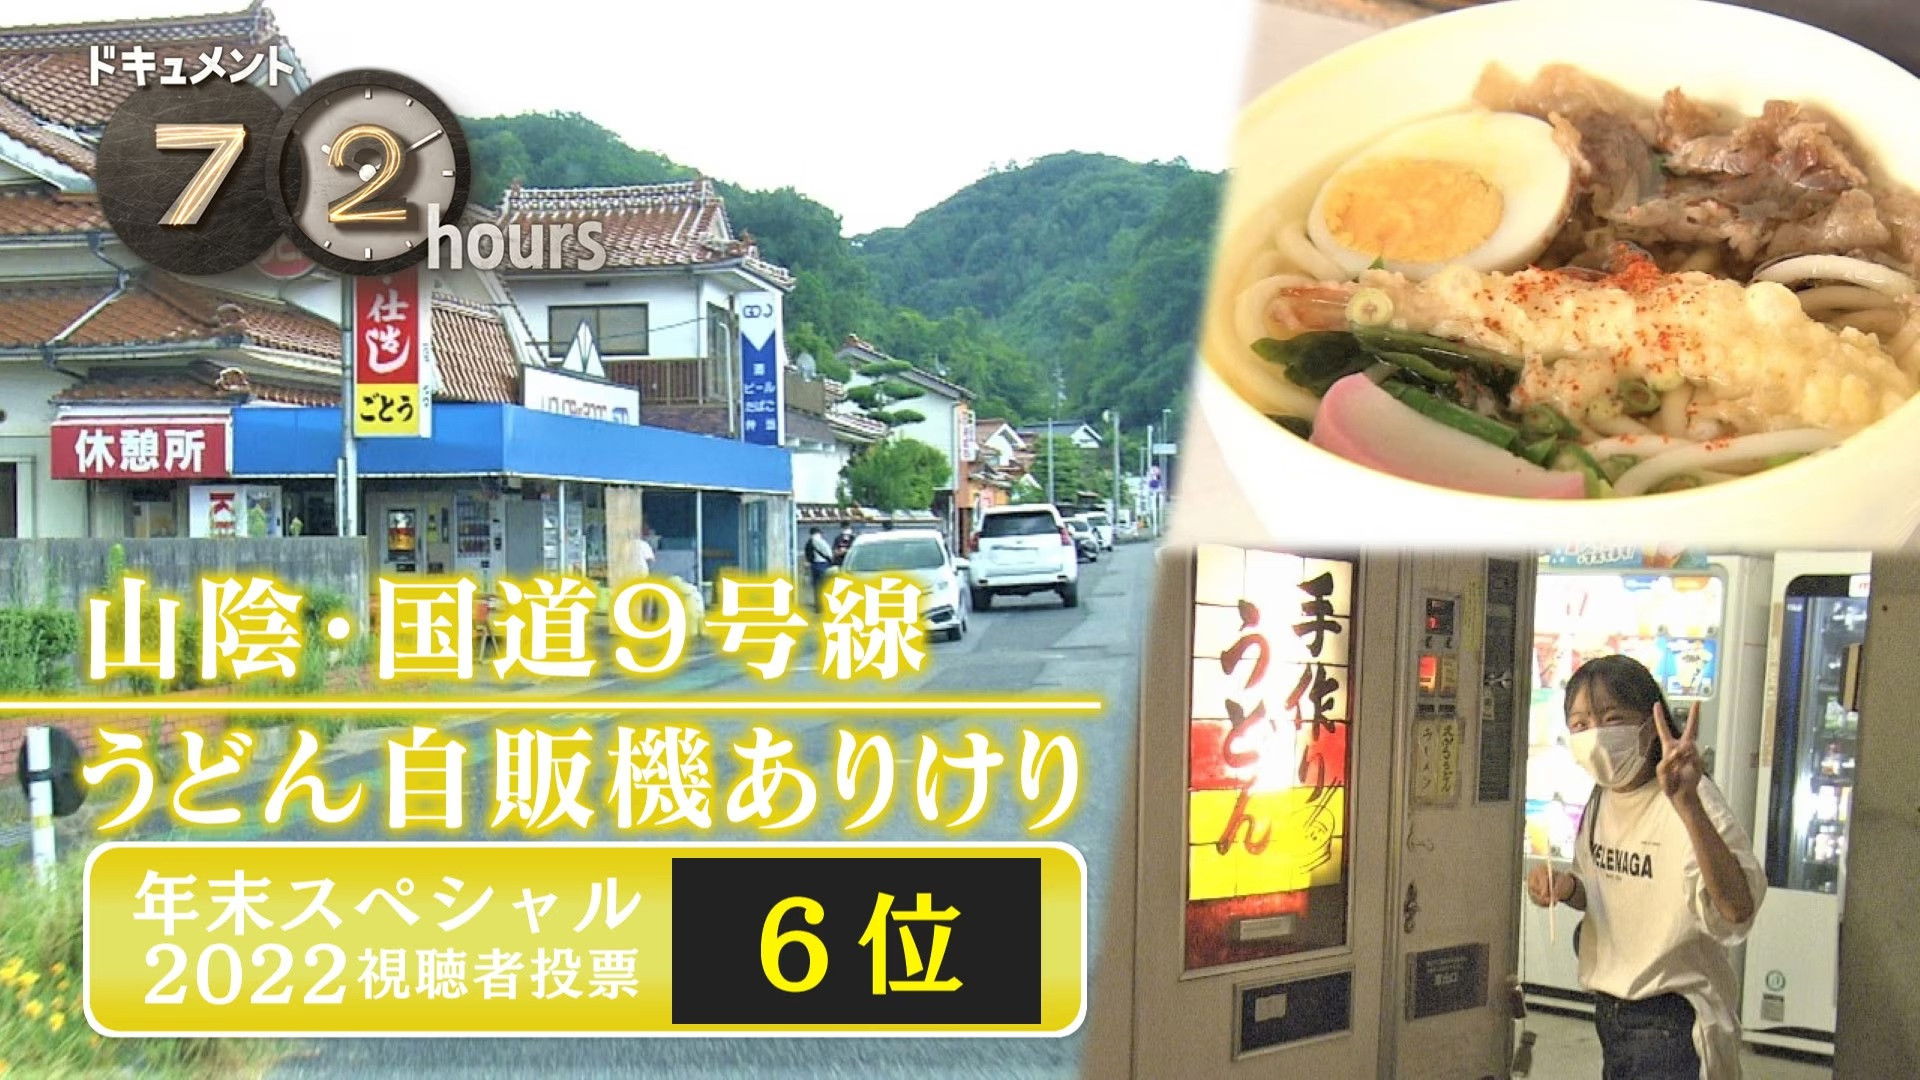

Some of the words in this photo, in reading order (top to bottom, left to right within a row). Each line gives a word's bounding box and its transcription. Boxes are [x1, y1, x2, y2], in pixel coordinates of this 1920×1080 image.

[74, 427, 206, 473] 休憩所
[360, 392, 414, 422] ごとう
[1215, 599, 1277, 856] うどん
[1291, 571, 1343, 804] 手作り
